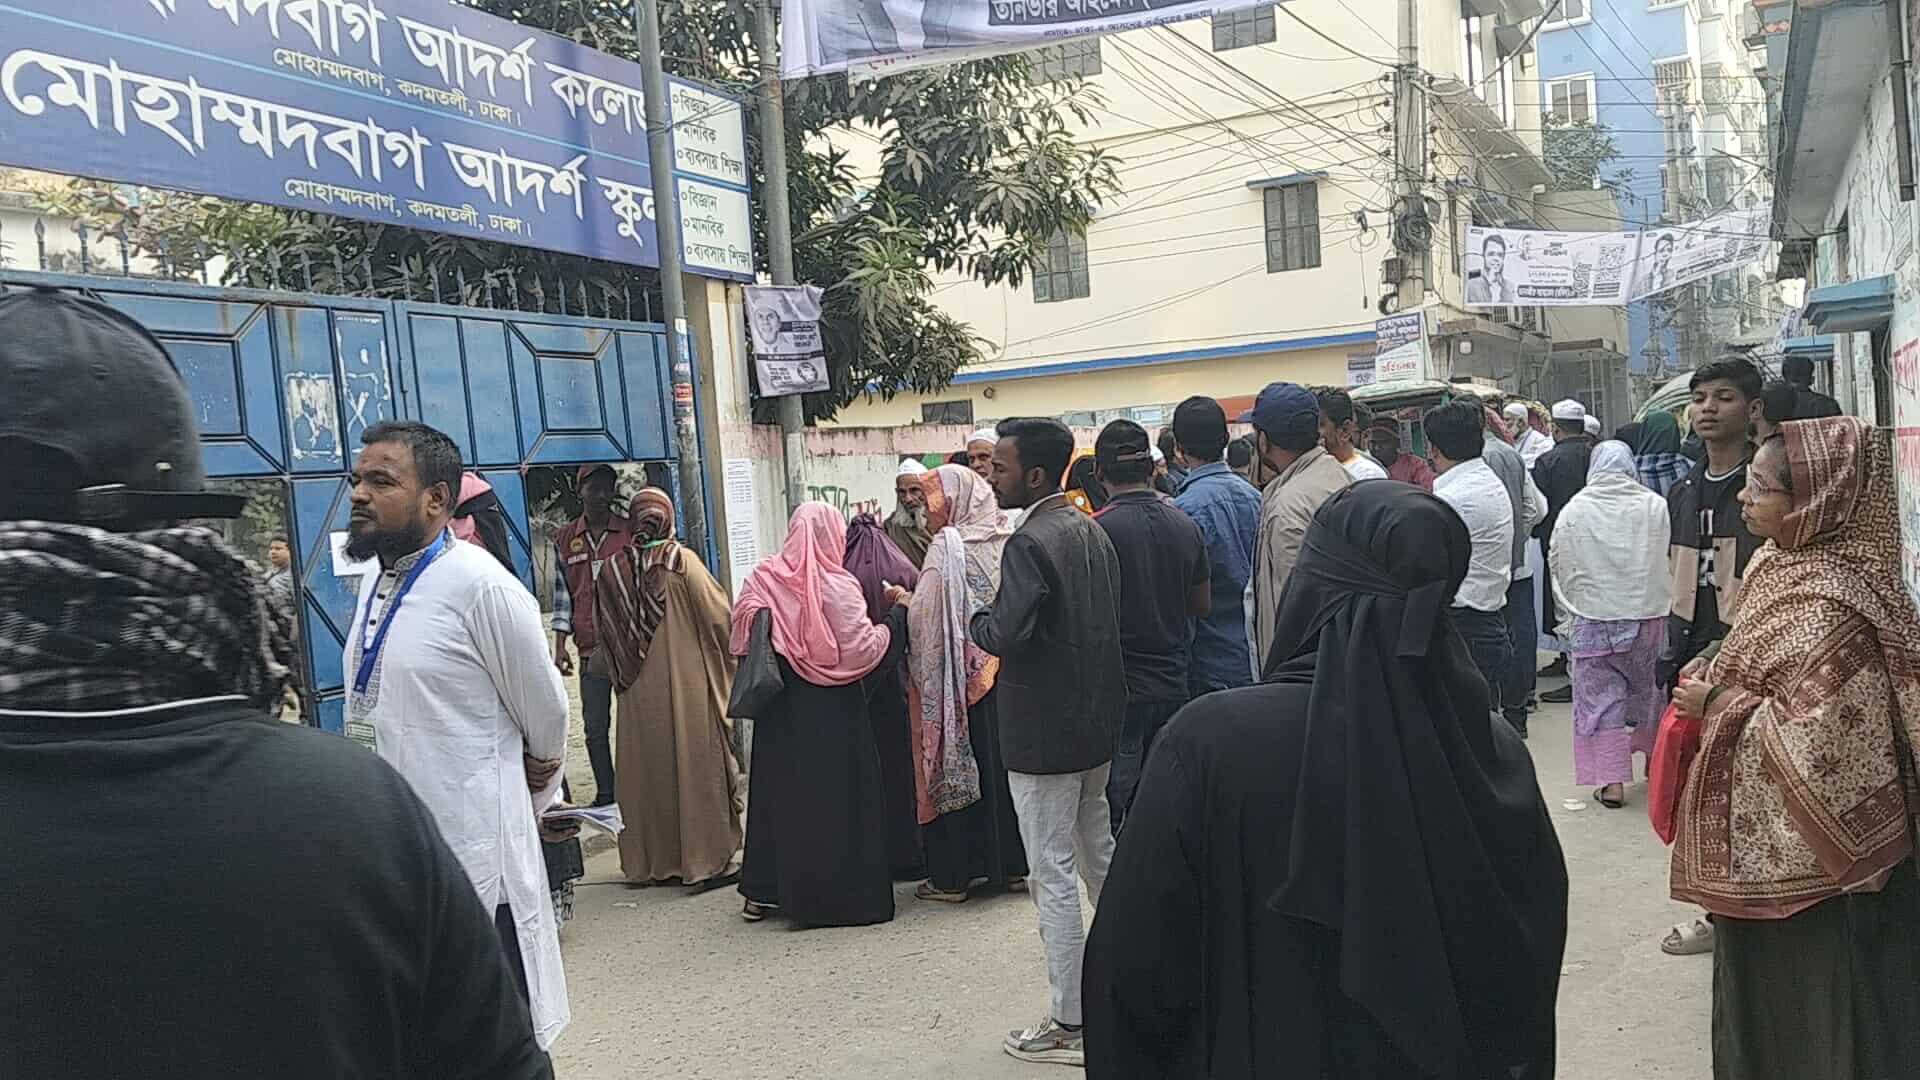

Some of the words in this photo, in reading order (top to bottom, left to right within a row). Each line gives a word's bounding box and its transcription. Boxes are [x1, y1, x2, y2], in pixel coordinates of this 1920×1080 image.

[397, 17, 537, 107] আদর্শ
[394, 78, 474, 117] কদমতলী,
[679, 88, 709, 113] বিজ্ঞান
[0, 48, 432, 192] মোহাম্মদবাগ
[440, 141, 587, 221] আদর্শ
[688, 185, 718, 212] বিজ্ঞান
[406, 199, 484, 232] কদমতলী,
[690, 214, 725, 239] মানবিক
